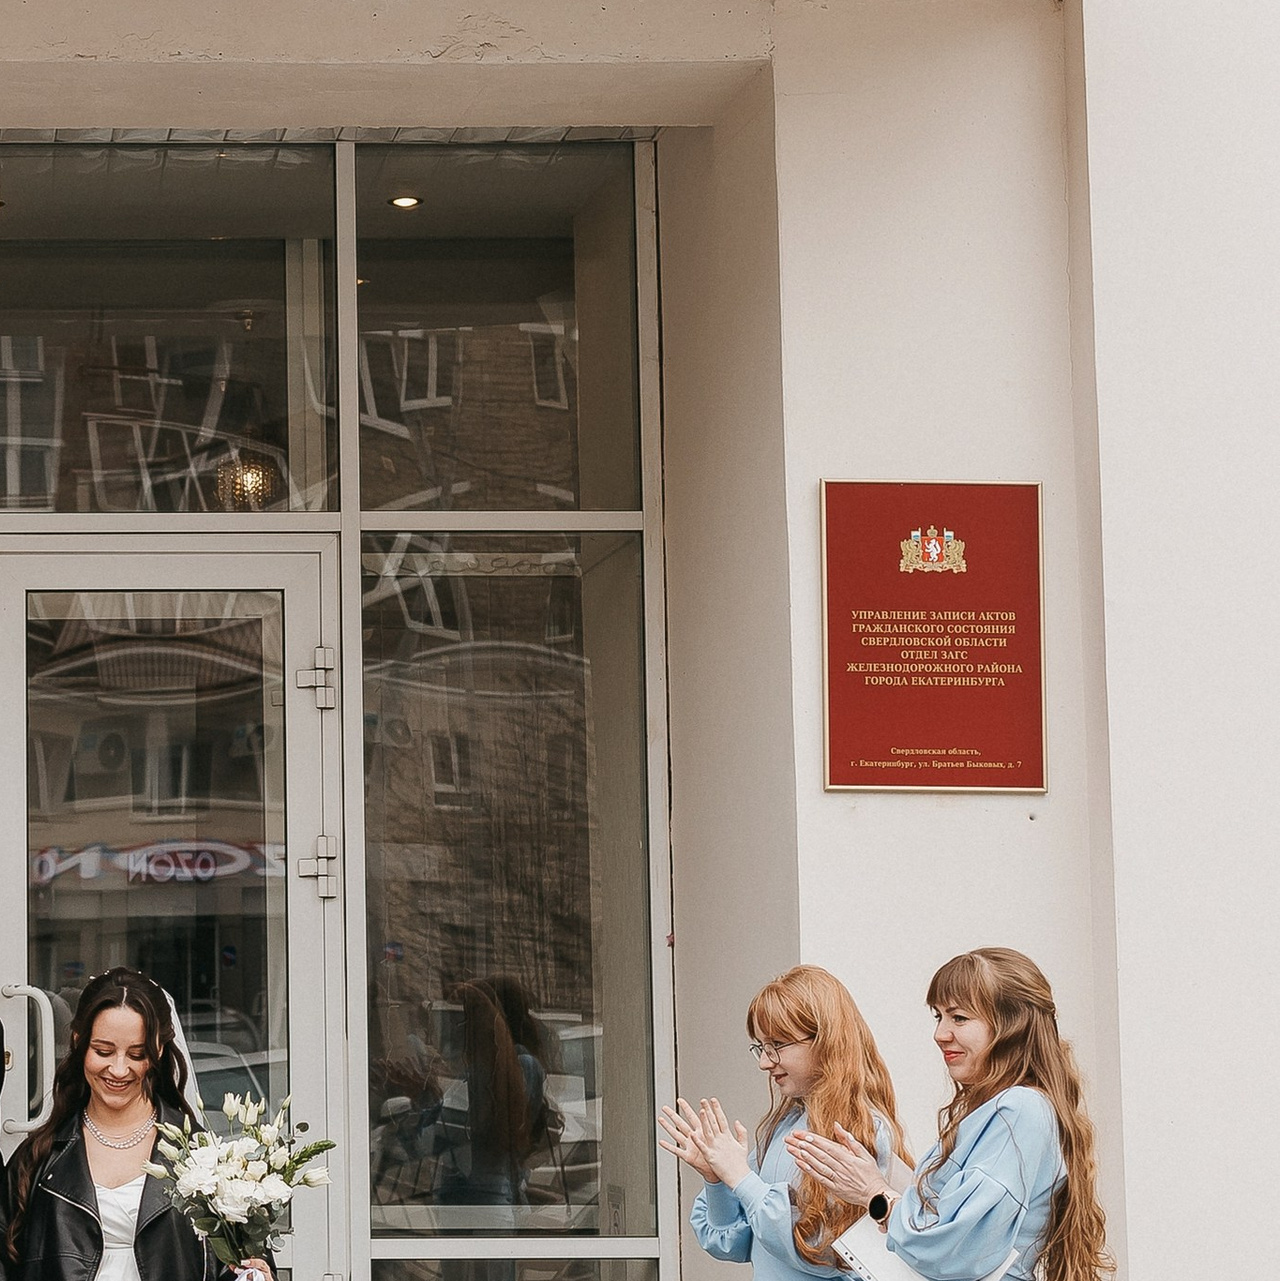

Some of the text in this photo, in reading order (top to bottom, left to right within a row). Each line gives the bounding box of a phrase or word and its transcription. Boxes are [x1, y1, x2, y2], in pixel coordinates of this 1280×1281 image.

[852, 611, 1015, 621] УПРАВЛЕНИЕ ЗАПИСИ АКТОВ
[853, 624, 1015, 635] ГРАЖДАНСКОГО СОСТОЯНИЯ
[862, 636, 1006, 647] СВЕРДЛОВСКОЙ ОБЛАСТИ
[901, 651, 967, 661] ОТДЕЛ ЗАГС
[847, 662, 1022, 674] ЖЕЛЕЗНОДОРОЖНОГО РАЙОНА
[865, 677, 1005, 687] ГОРОДА ЕКАТЕРИНБУРГА
[891, 748, 946, 757] Свердловская
